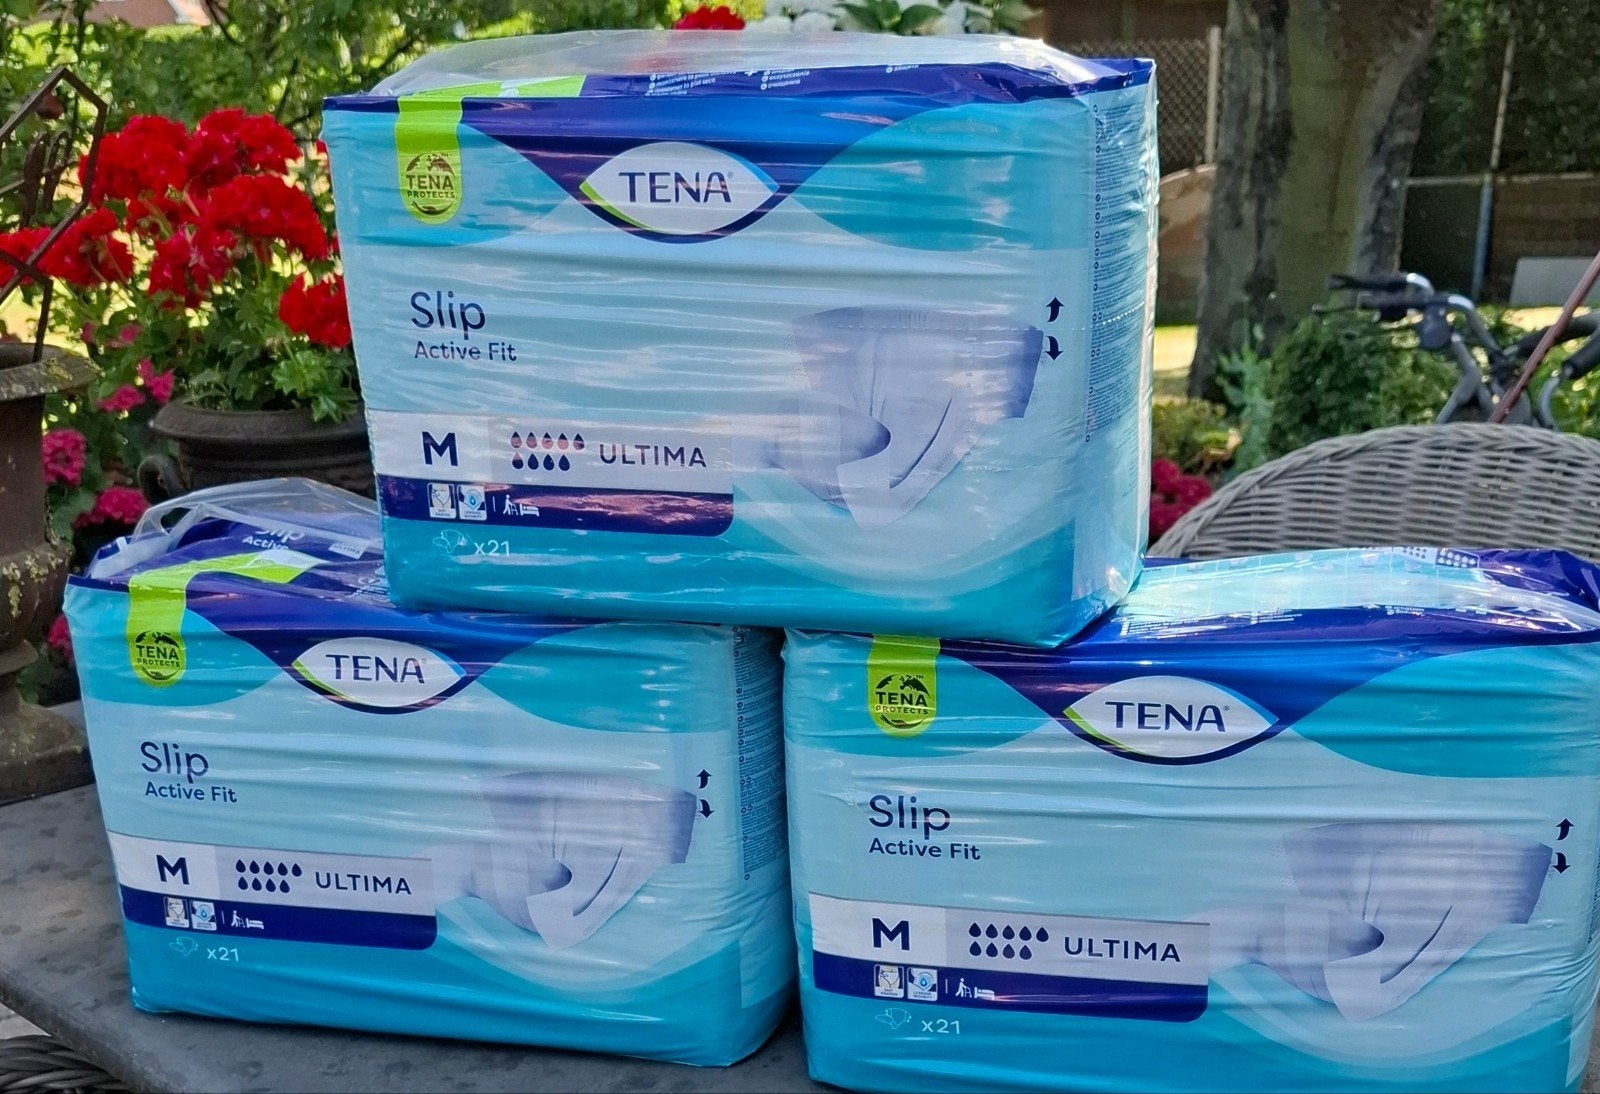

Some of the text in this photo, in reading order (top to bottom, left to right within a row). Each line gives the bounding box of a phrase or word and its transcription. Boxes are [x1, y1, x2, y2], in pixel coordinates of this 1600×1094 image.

[406, 174, 453, 190] TENA
[619, 171, 732, 203] TENA
[406, 190, 456, 199] PROTECTS
[410, 290, 486, 340] Slip
[414, 340, 518, 362] Active Fit
[421, 431, 459, 467] M
[599, 443, 707, 469] ULTIMA
[473, 540, 512, 557] x21
[135, 645, 180, 660] TENA
[136, 658, 181, 668] PROTECTS
[325, 654, 425, 684] TENA
[875, 691, 928, 707] TENA
[875, 705, 929, 715] PROTECTS
[1104, 701, 1226, 733] TENA
[140, 741, 209, 784] Slip
[145, 781, 238, 803] Active Fit
[868, 794, 951, 840] Slip
[868, 837, 981, 861] Active Fit
[156, 854, 190, 885] M
[315, 871, 412, 895] ULTIMA
[871, 917, 910, 951] M
[207, 947, 240, 962] x21
[1064, 936, 1181, 963] ULTIMA
[921, 1018, 961, 1034] x21
